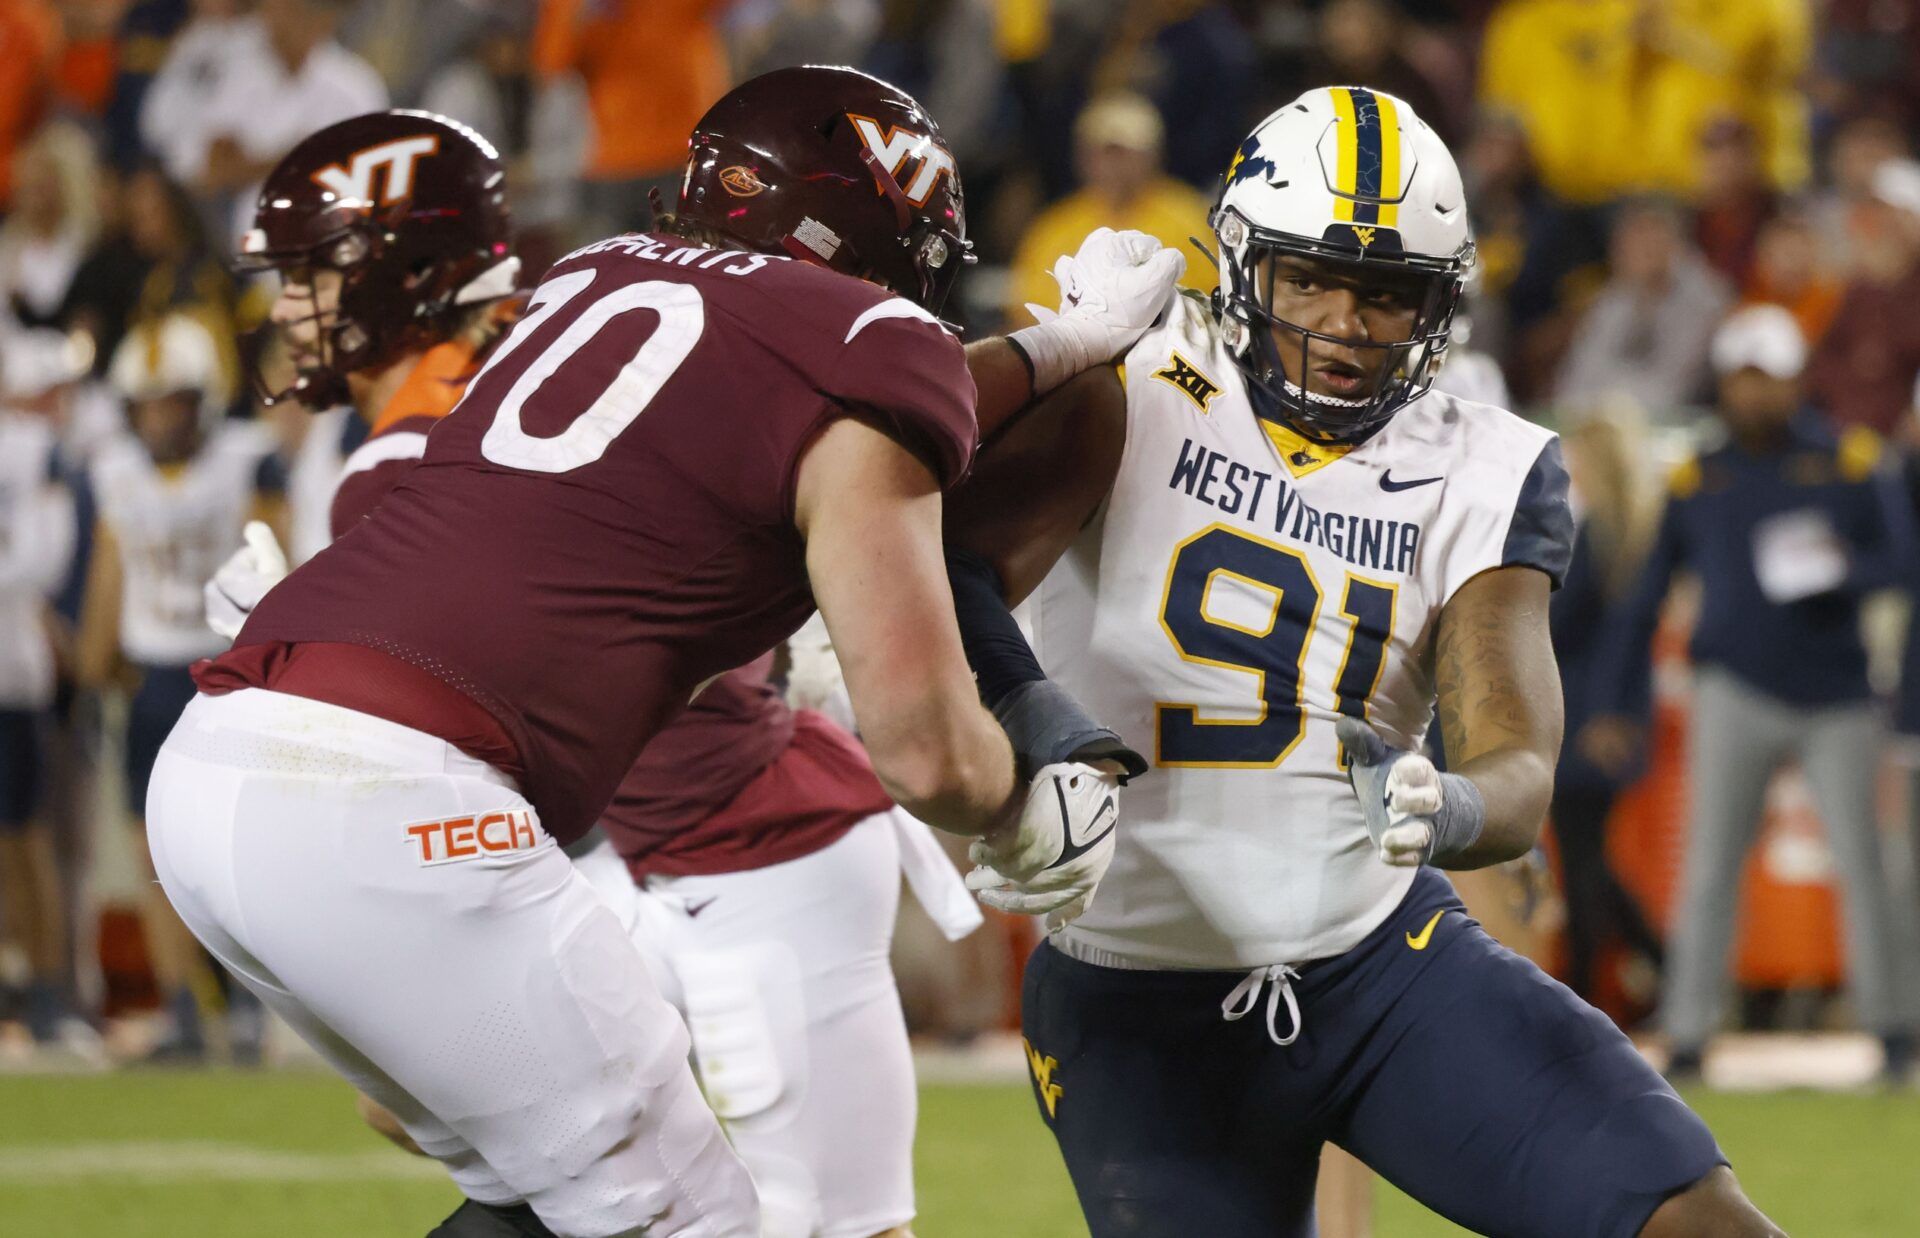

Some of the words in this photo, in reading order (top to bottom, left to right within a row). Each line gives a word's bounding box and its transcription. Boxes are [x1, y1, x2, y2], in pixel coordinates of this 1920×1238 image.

[310, 134, 440, 217] VT
[846, 113, 956, 209] VT
[450, 267, 705, 473] 70
[1152, 350, 1223, 413] XII
[1169, 438, 1271, 522] WEST
[1275, 480, 1420, 576] VIRGINIA
[1155, 521, 1399, 771] 91
[407, 811, 535, 861] TECH
